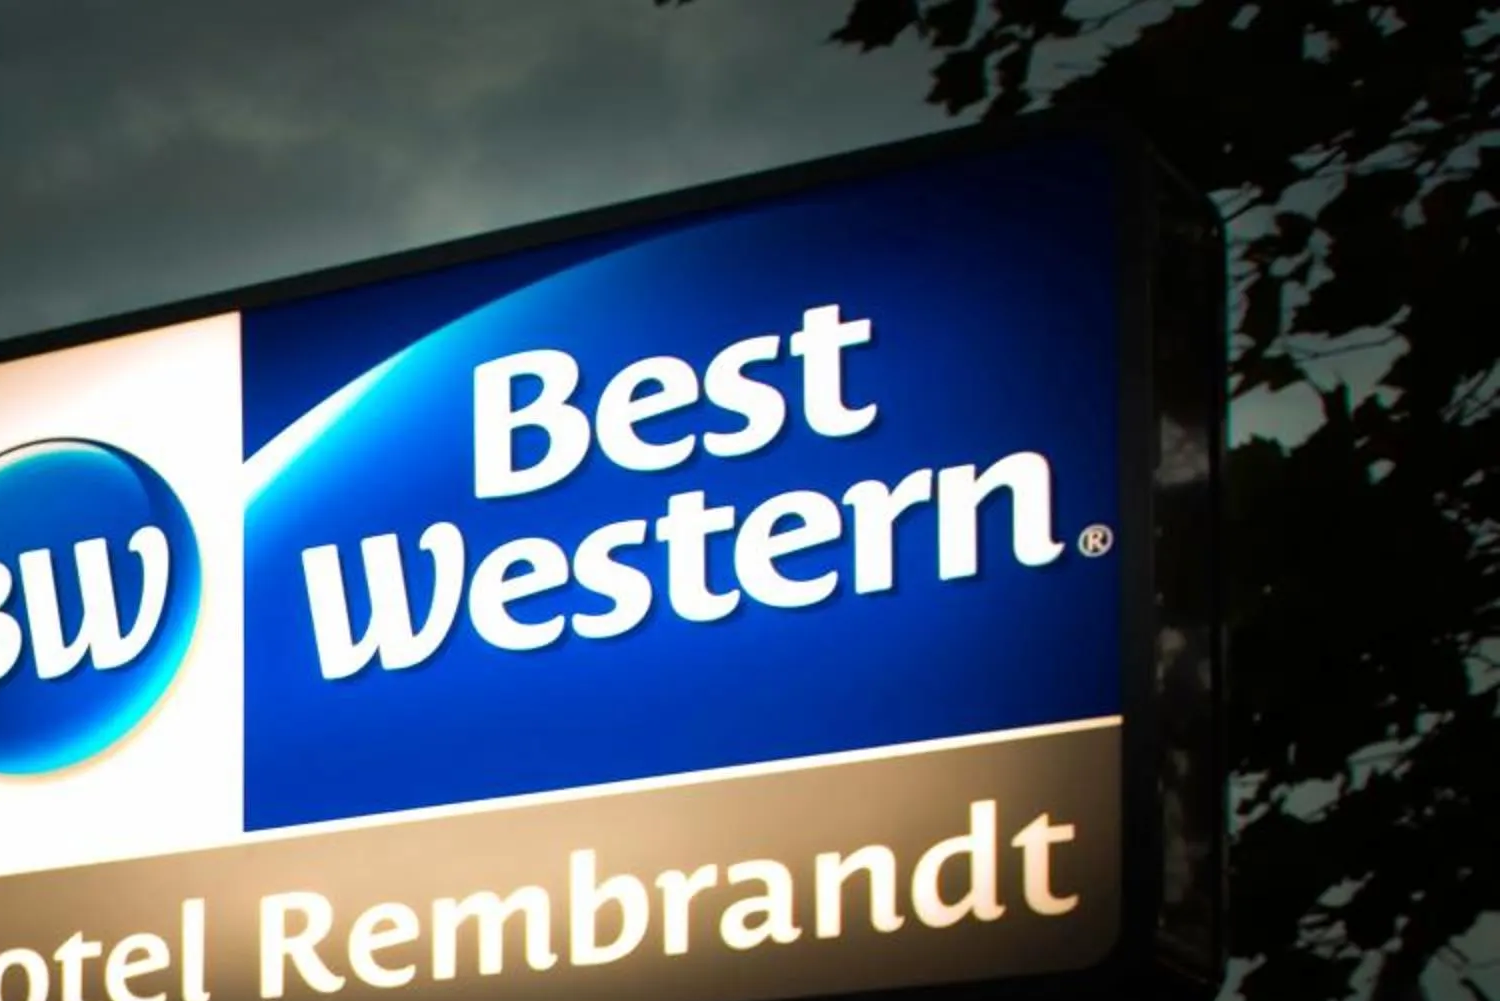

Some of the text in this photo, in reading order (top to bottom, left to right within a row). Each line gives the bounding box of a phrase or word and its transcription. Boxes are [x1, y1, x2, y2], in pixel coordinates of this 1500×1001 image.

[470, 303, 878, 500] Best
[301, 449, 1065, 681] Western
[258, 799, 1080, 1001] Rembrandt
